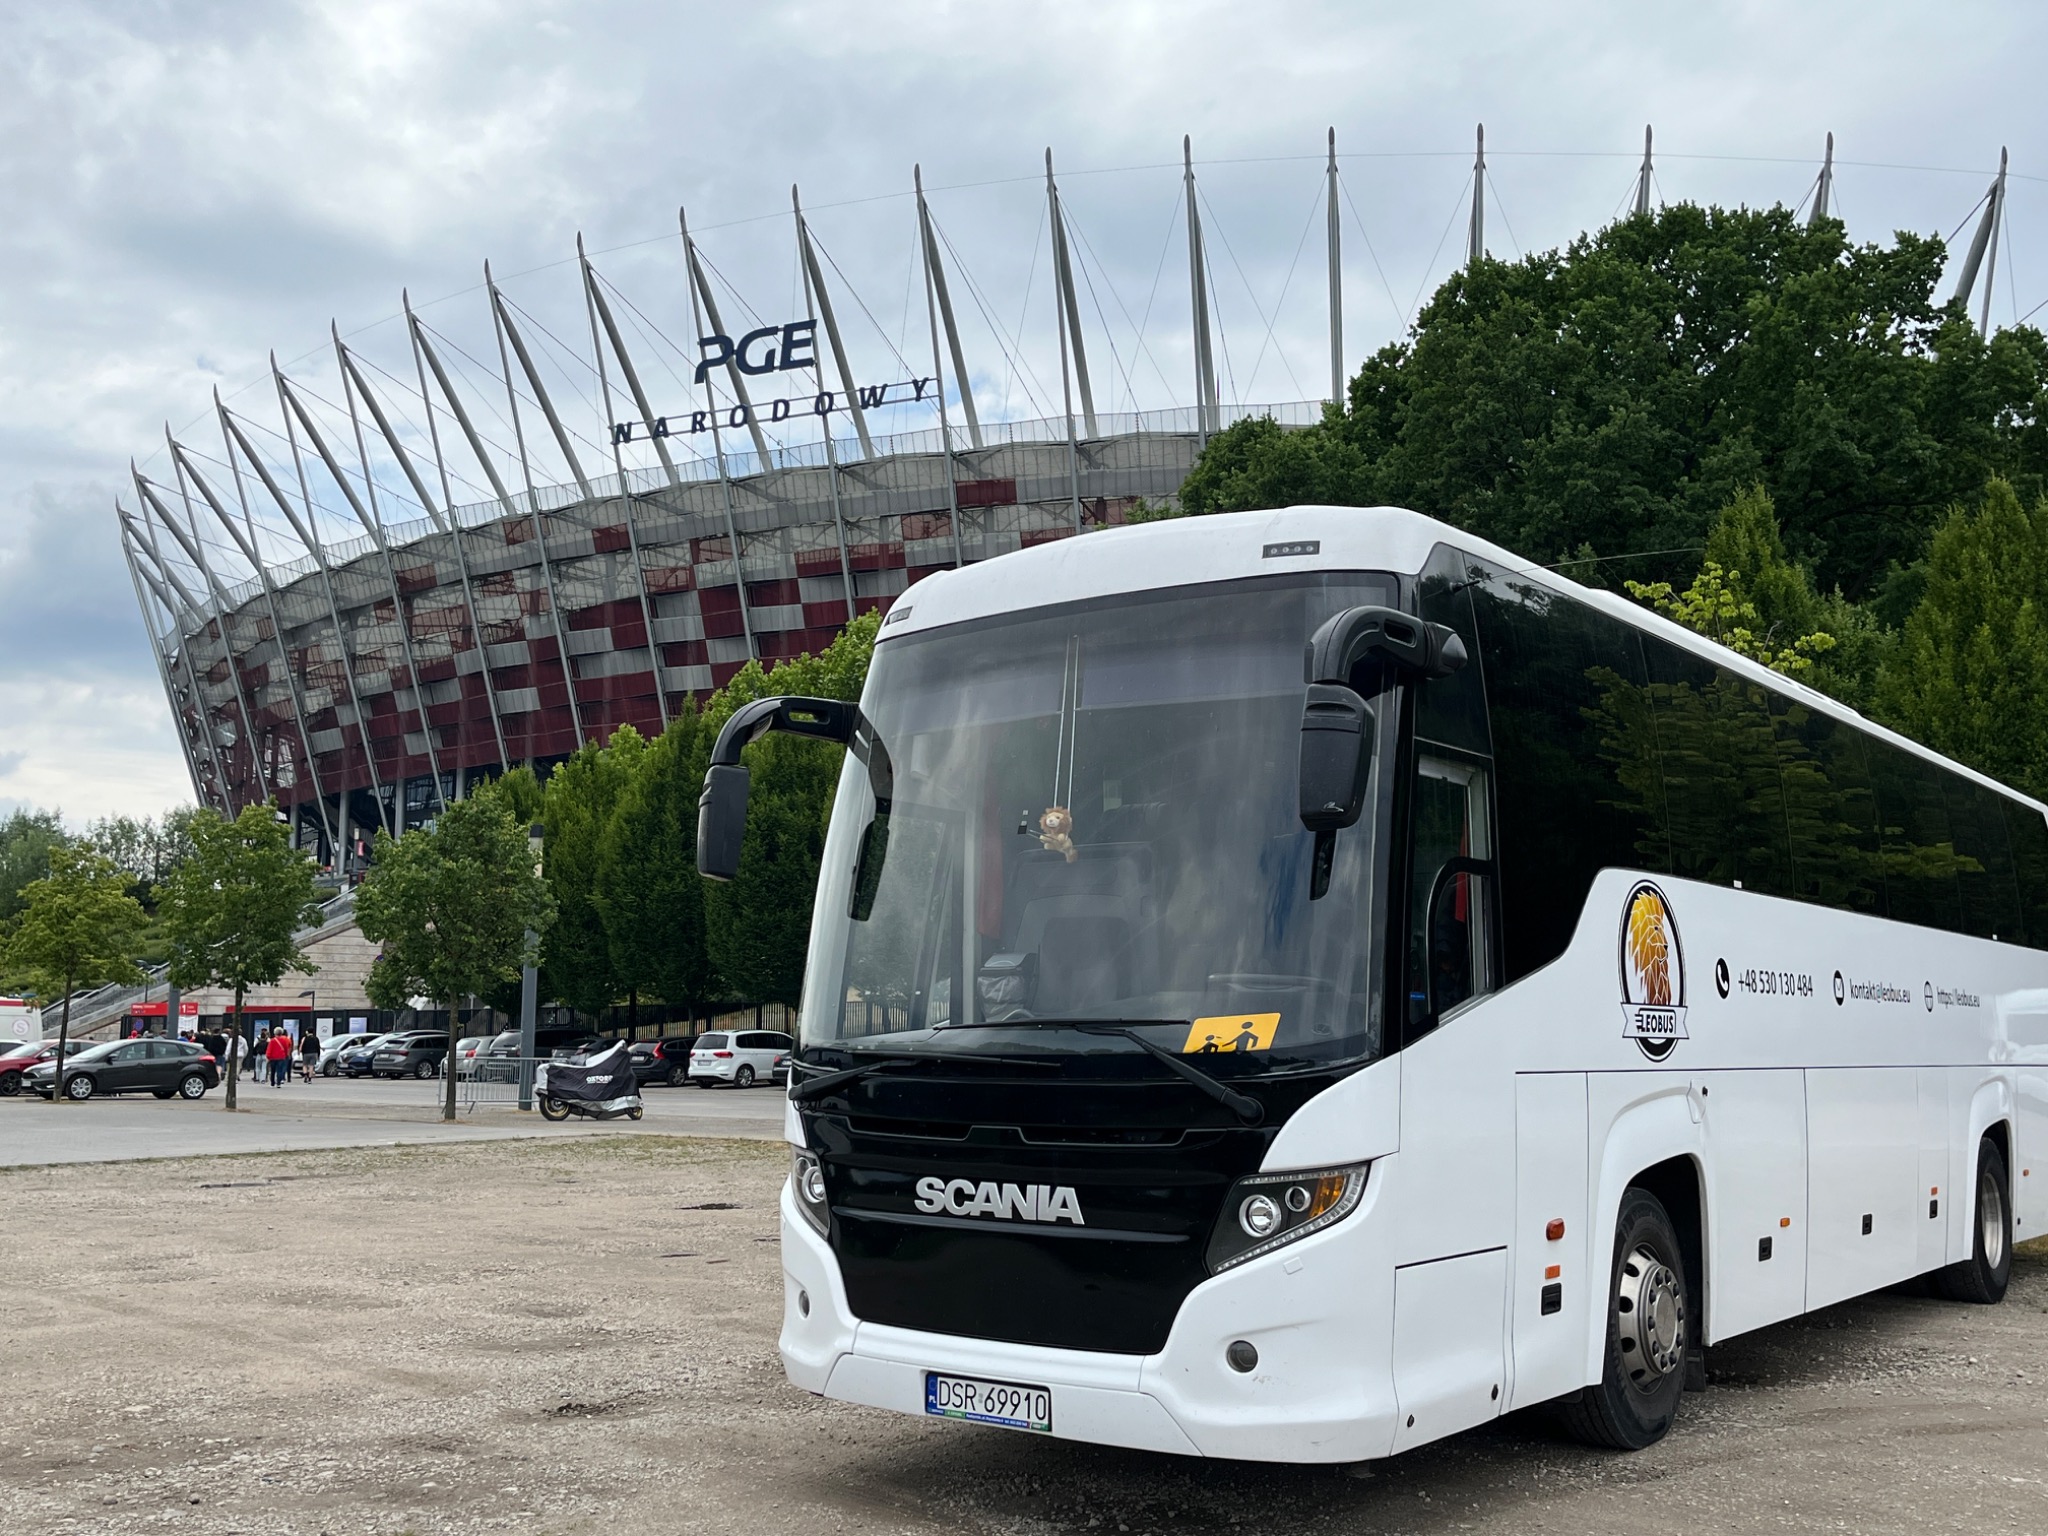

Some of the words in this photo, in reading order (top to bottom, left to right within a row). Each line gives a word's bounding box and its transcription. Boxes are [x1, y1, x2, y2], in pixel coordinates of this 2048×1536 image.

[694, 318, 818, 385] PGE
[614, 377, 930, 444] NARODOWY
[1738, 968, 1758, 993] +48
[1759, 970, 1777, 995] 530
[1779, 972, 1796, 997] 130
[1797, 974, 1813, 998] 484
[1849, 978, 1911, 1004] kontakt@leobus.eu
[1634, 1013, 1674, 1034] LEOBUS
[914, 1176, 1086, 1225] SCANIA
[938, 1380, 977, 1412] DSR
[983, 1386, 1047, 1421] 69910
